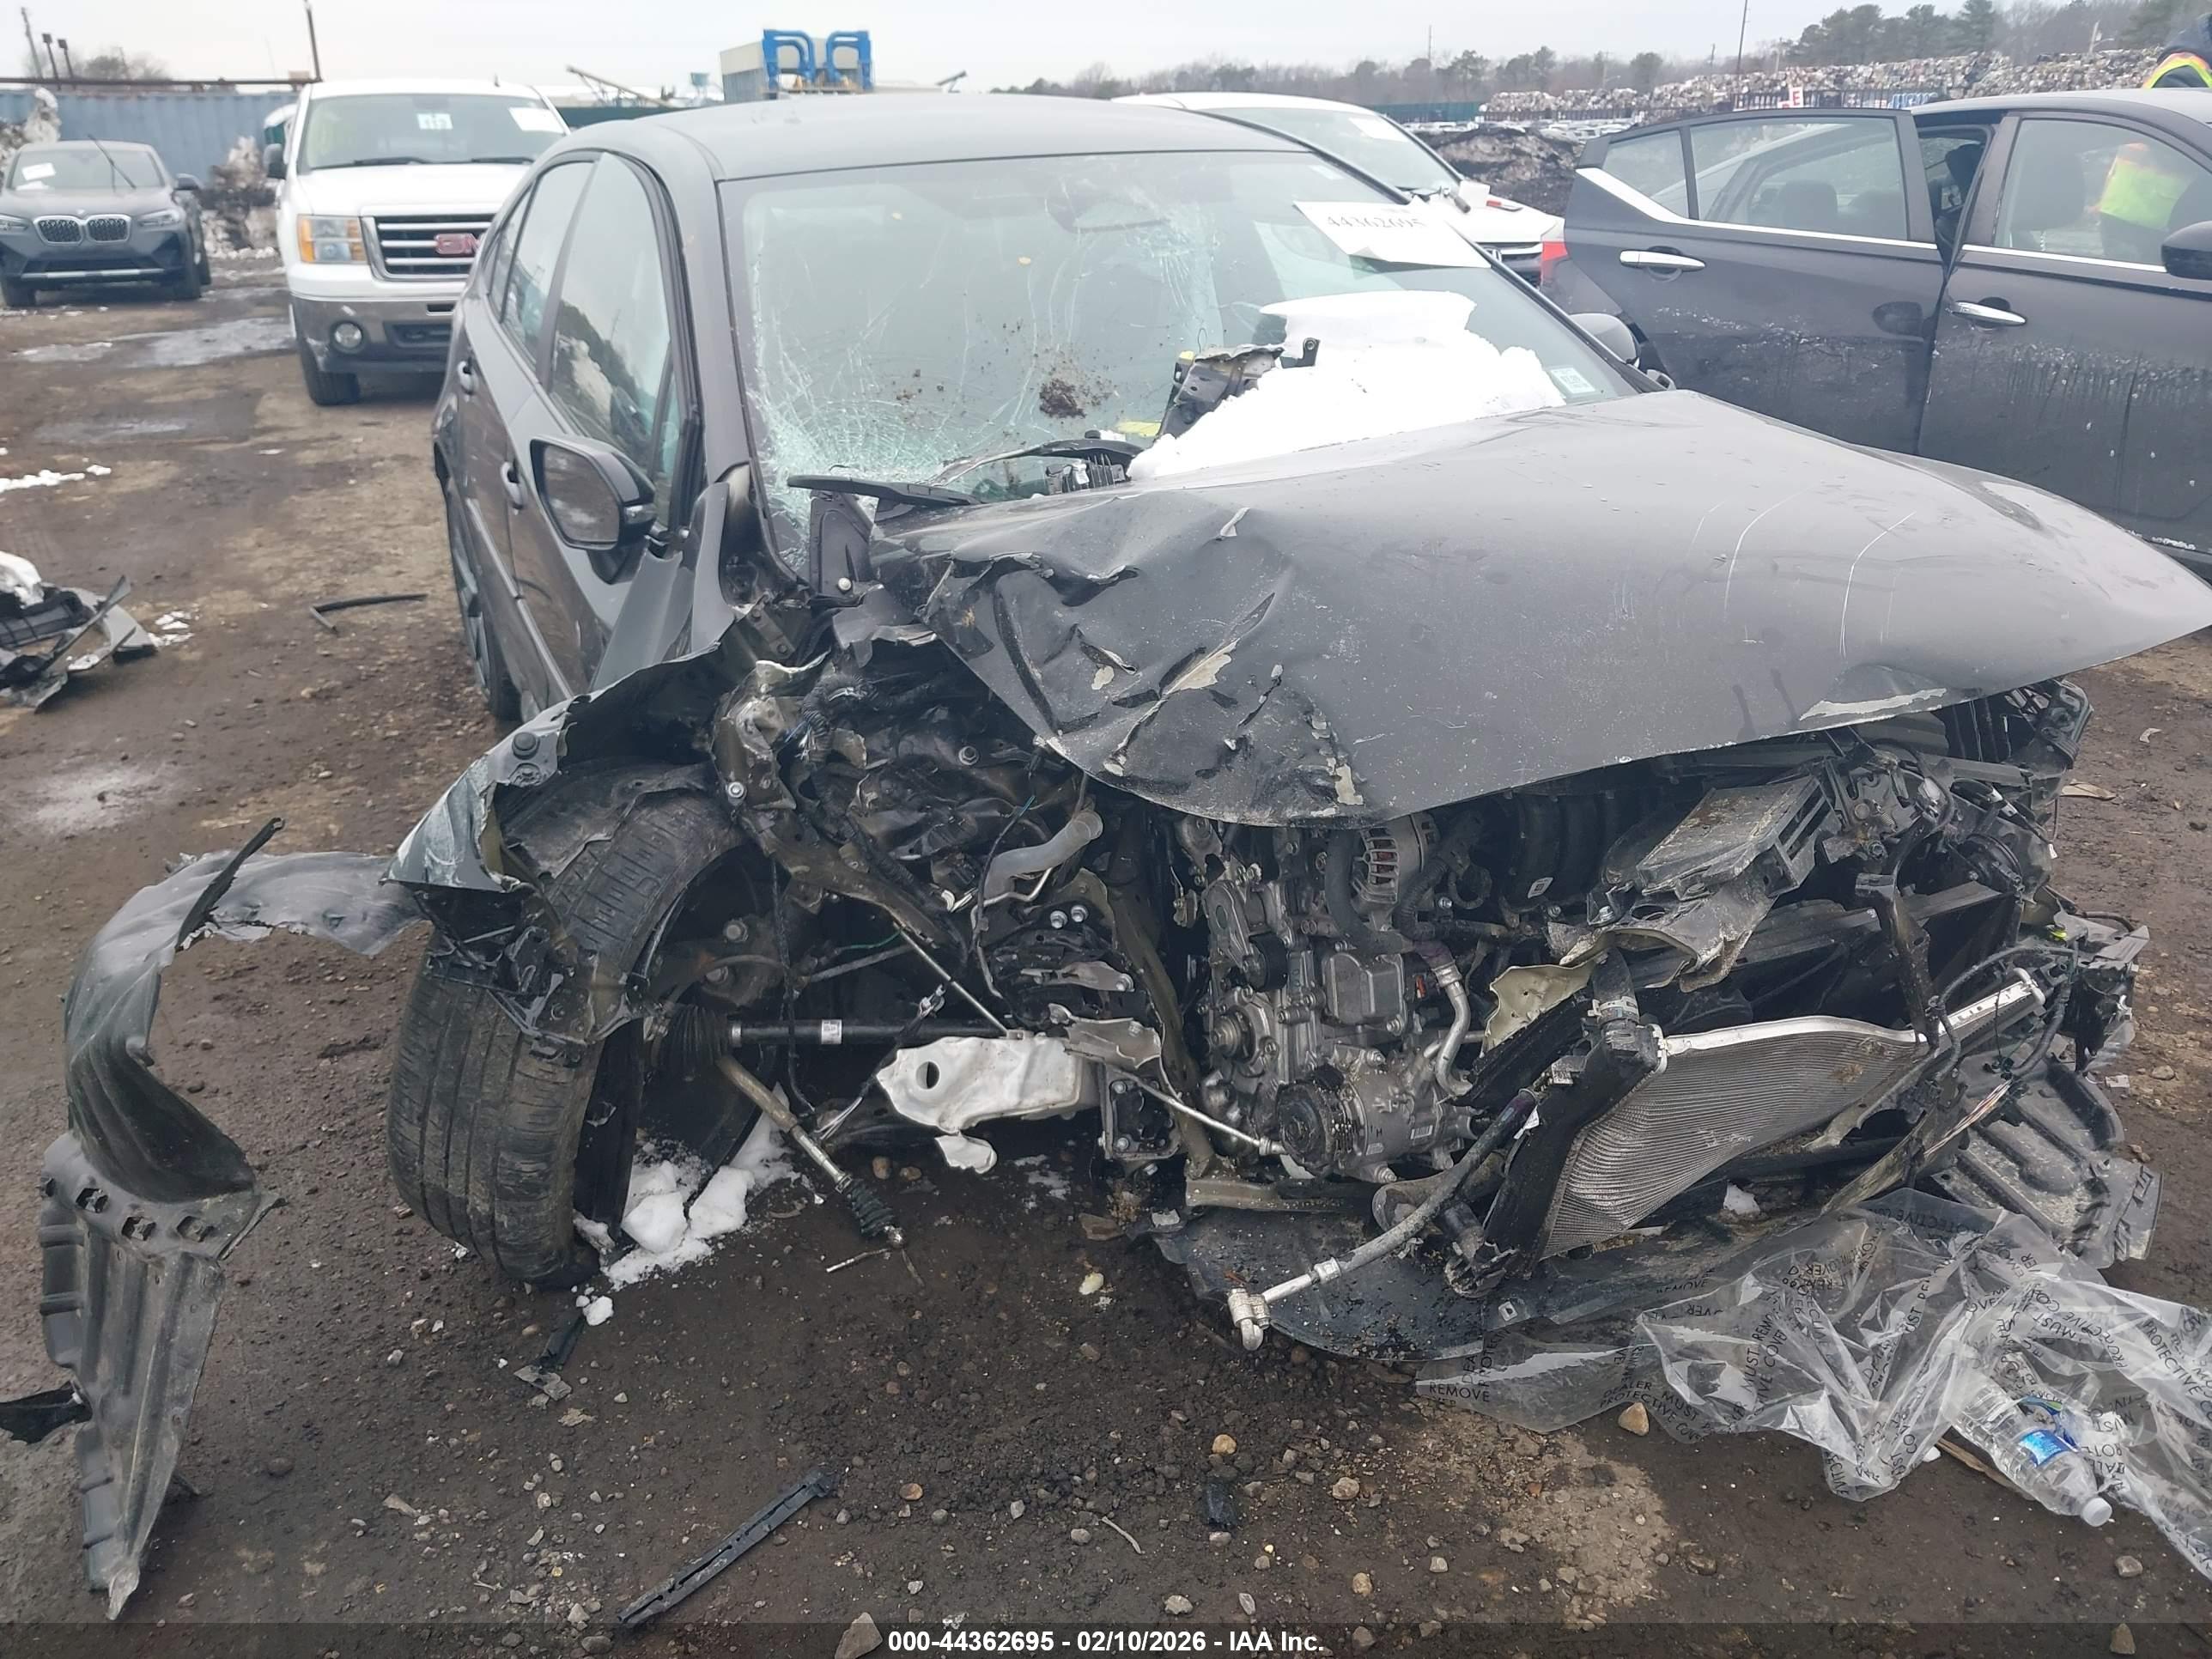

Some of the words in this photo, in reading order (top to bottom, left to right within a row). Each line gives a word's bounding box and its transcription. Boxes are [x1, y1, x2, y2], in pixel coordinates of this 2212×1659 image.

[2032, 1313, 2077, 1340] MUST
[1741, 1347, 1760, 1393] MUST
[2142, 1320, 2203, 1396] PROTECTIVE
[1429, 1382, 1491, 1403] REMOVE
[1600, 1389, 1677, 1424] PROTECTIVE
[1662, 1390, 1698, 1423] MUST
